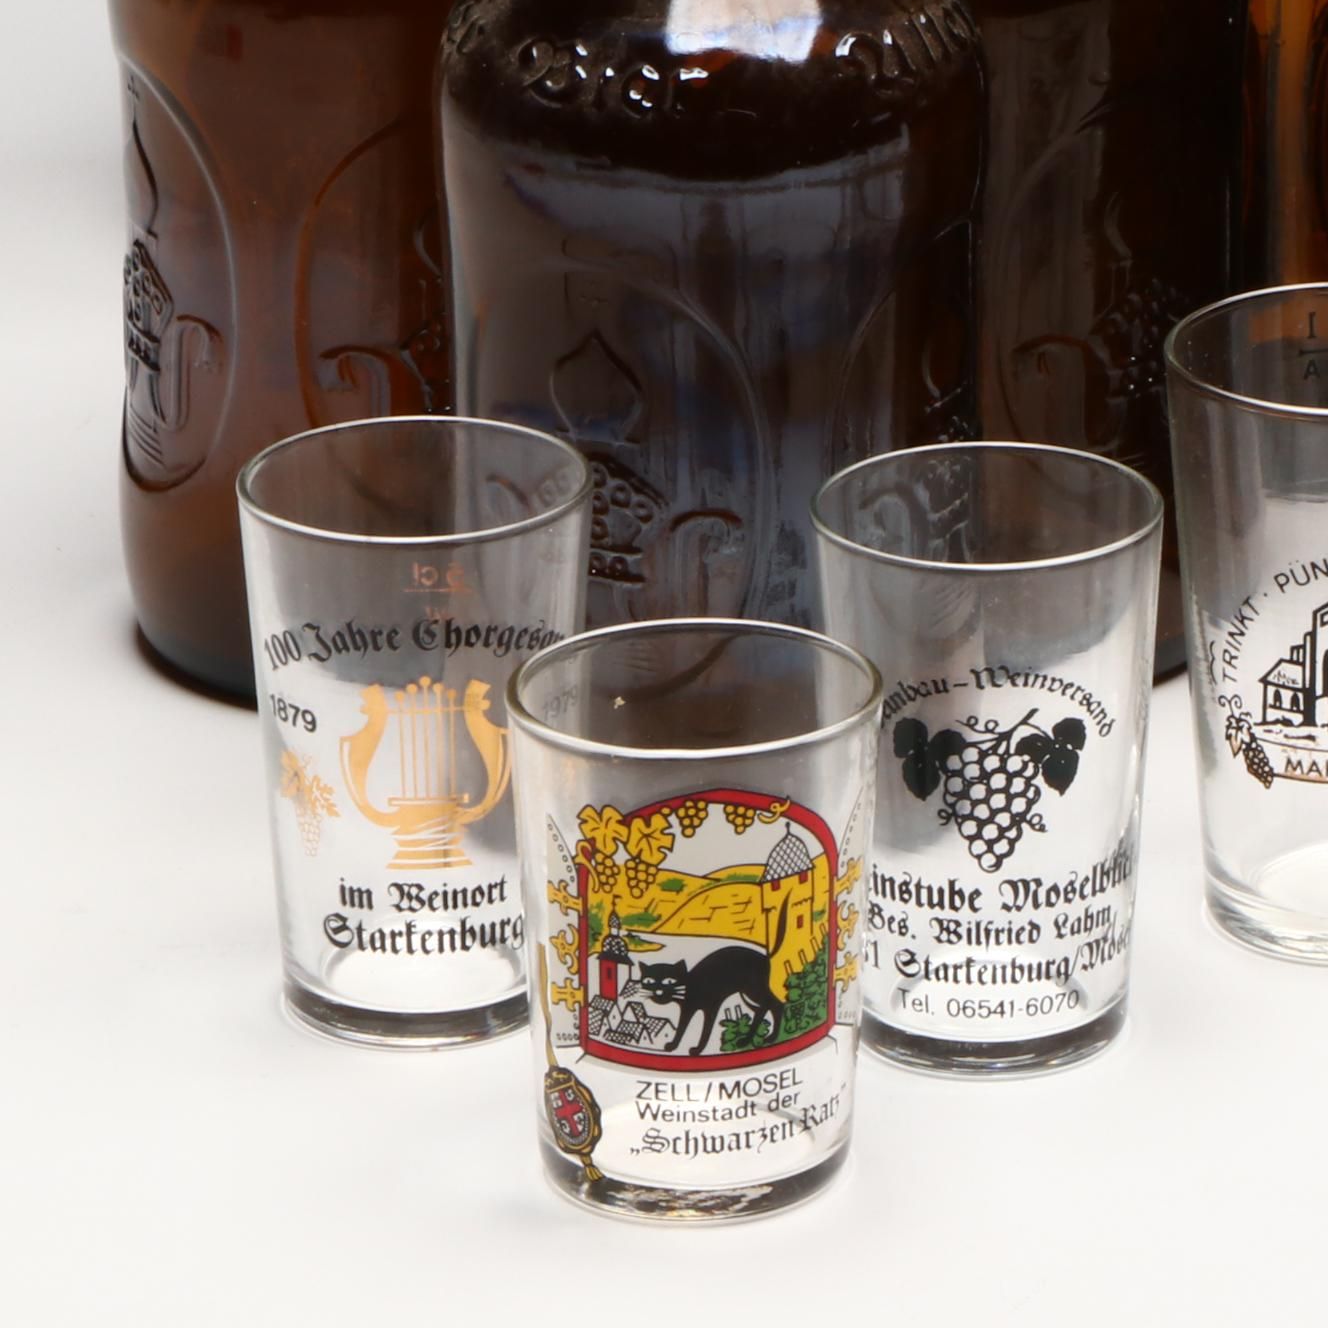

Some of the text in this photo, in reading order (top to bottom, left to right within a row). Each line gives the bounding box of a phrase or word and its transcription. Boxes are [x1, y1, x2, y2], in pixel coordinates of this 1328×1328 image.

[264, 618, 565, 671] 100 Jahre Chorgesa
[1222, 596, 1262, 683] TRINKT
[269, 694, 318, 734] 1879
[338, 875, 508, 913] im Weinort
[869, 862, 983, 913] instube
[323, 912, 525, 956] Starkenburg
[929, 914, 1042, 953] Wilfried
[1053, 903, 1112, 940] Lahm
[897, 988, 1080, 1019] Tel. 06541-6070
[635, 1090, 801, 1123] Weinstadt der
